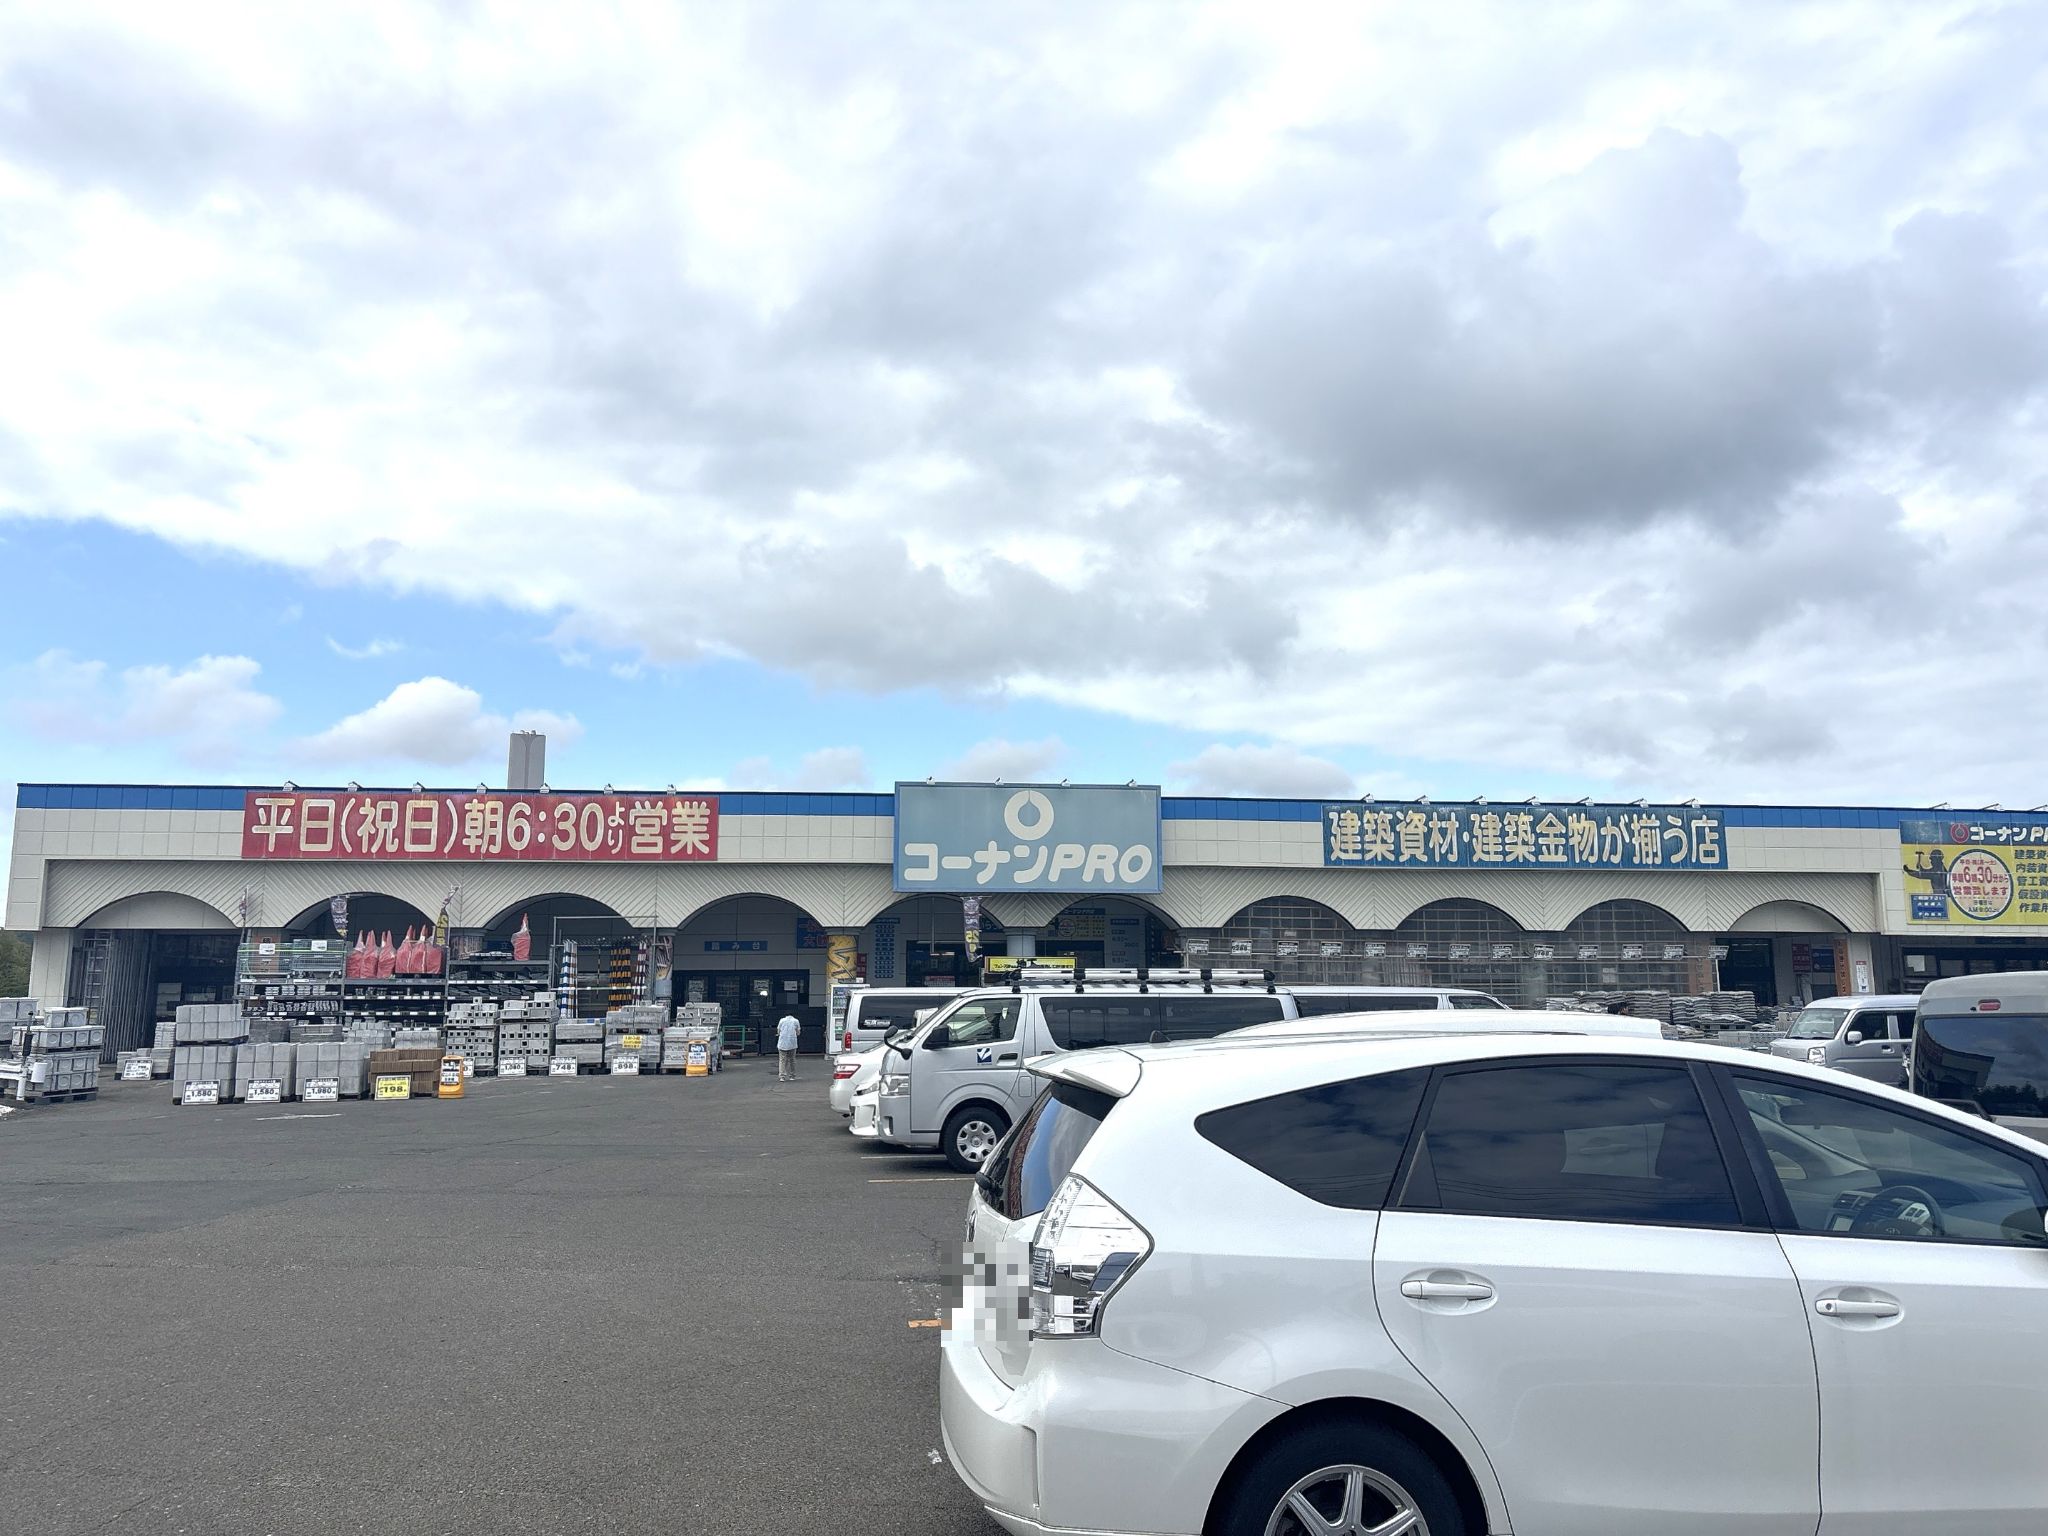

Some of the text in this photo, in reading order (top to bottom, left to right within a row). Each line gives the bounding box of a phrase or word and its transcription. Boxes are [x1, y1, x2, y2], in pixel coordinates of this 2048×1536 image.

[251, 797, 711, 856] 平日(祝日)朝6:30より営業
[1328, 808, 1722, 866] 建築資材・建築金物が揃う店
[903, 839, 1153, 885] コーナンPRO
